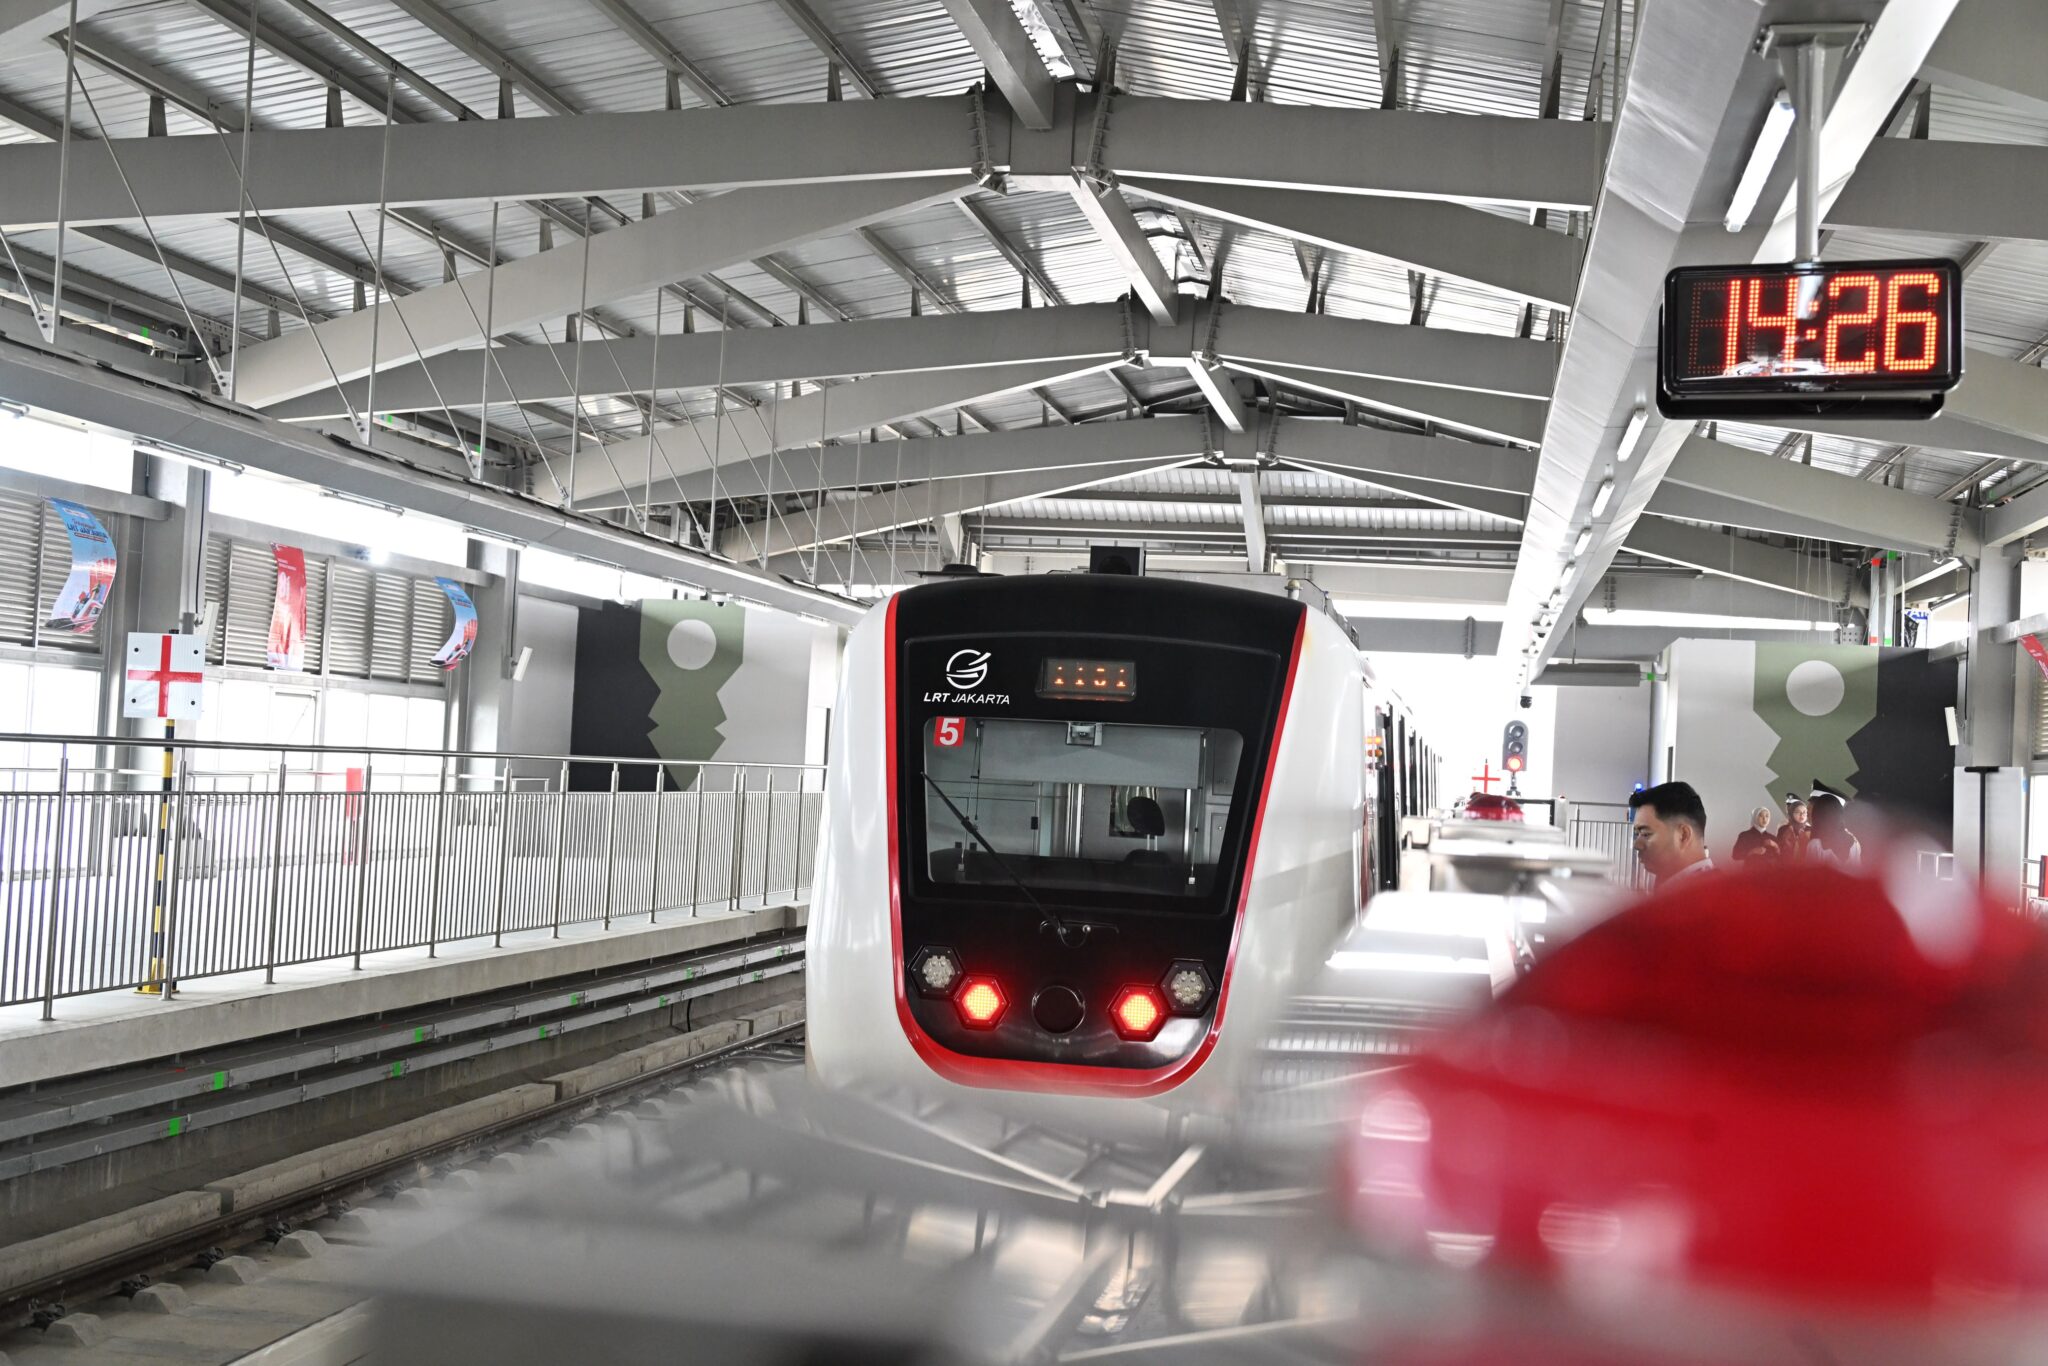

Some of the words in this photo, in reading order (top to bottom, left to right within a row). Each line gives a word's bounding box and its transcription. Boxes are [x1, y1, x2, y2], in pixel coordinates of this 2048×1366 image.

[1723, 273, 1940, 376] 14:26
[923, 692, 950, 703] LRT
[951, 693, 1010, 705] JAKARTA
[940, 717, 960, 746] 5
